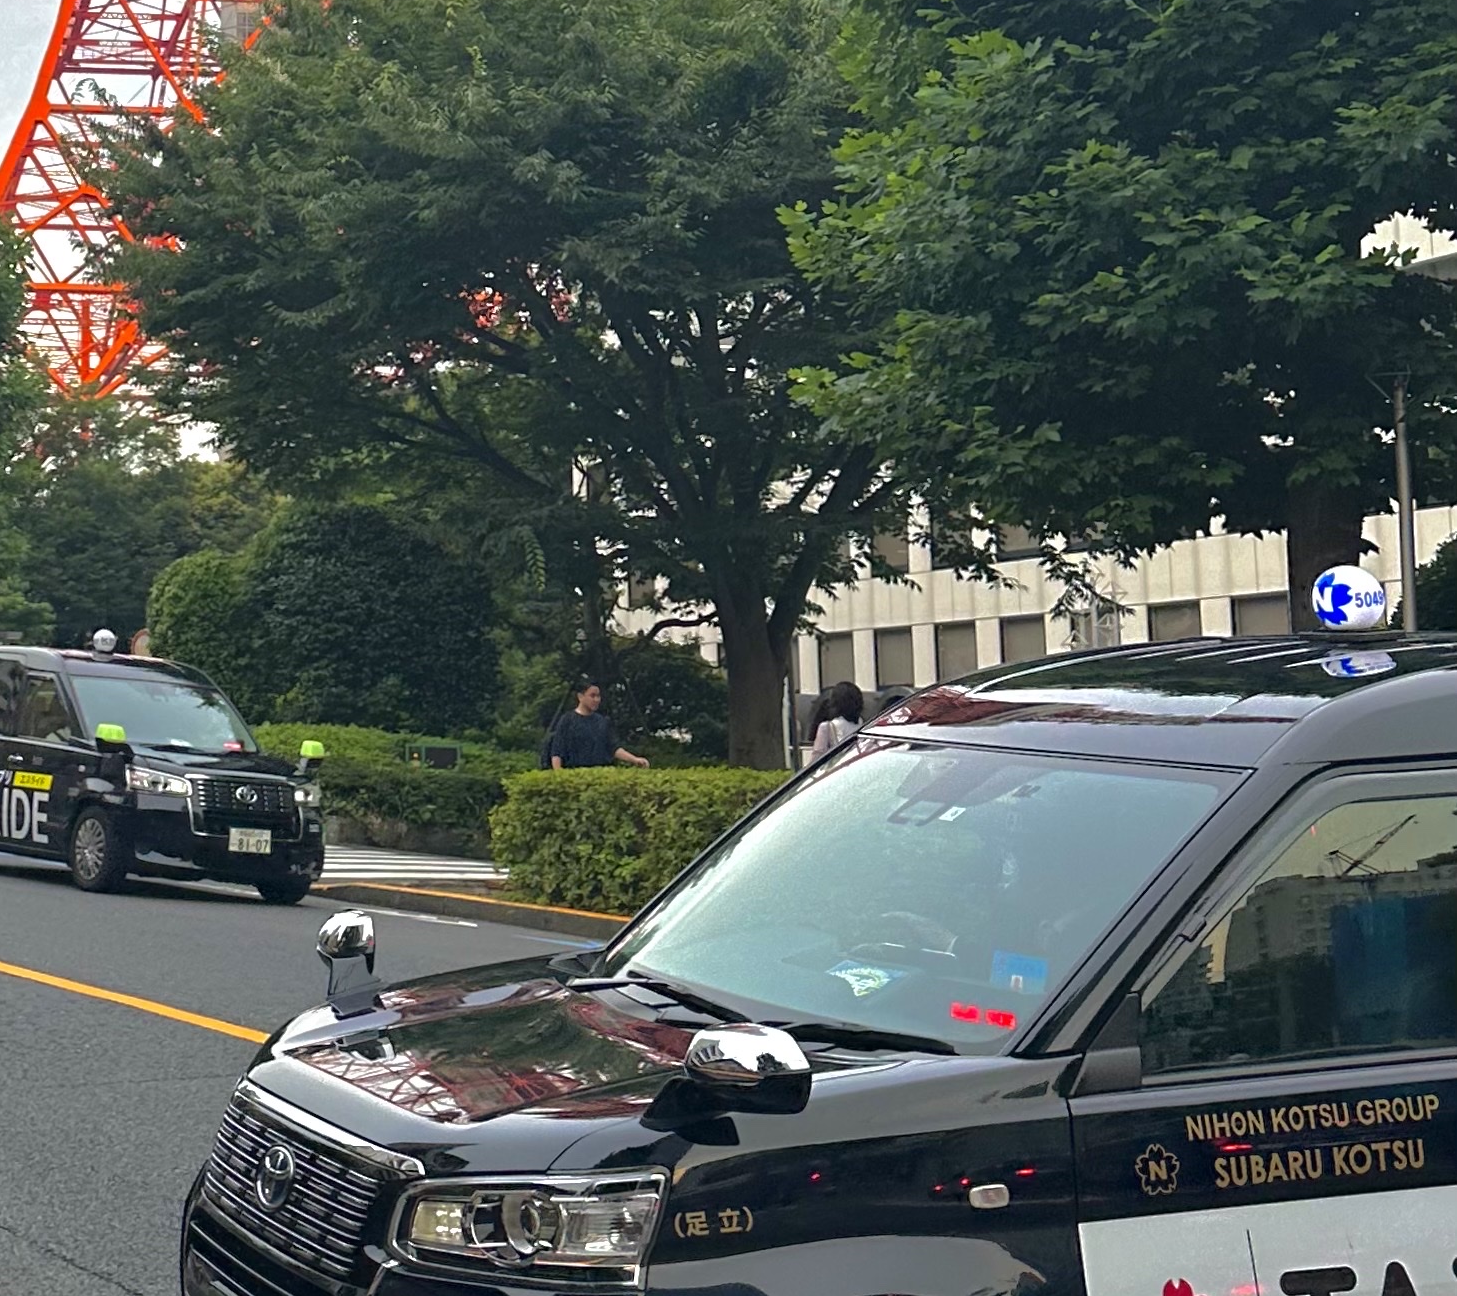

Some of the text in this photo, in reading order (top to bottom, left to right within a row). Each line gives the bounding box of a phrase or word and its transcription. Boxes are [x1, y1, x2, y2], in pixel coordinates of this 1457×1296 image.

[1355, 590, 1383, 608] 5049
[1185, 1093, 1441, 1142] NIHON KOTSU GROUP
[1148, 1159, 1169, 1181] N
[1214, 1138, 1425, 1189] SUBARU KOTSU
